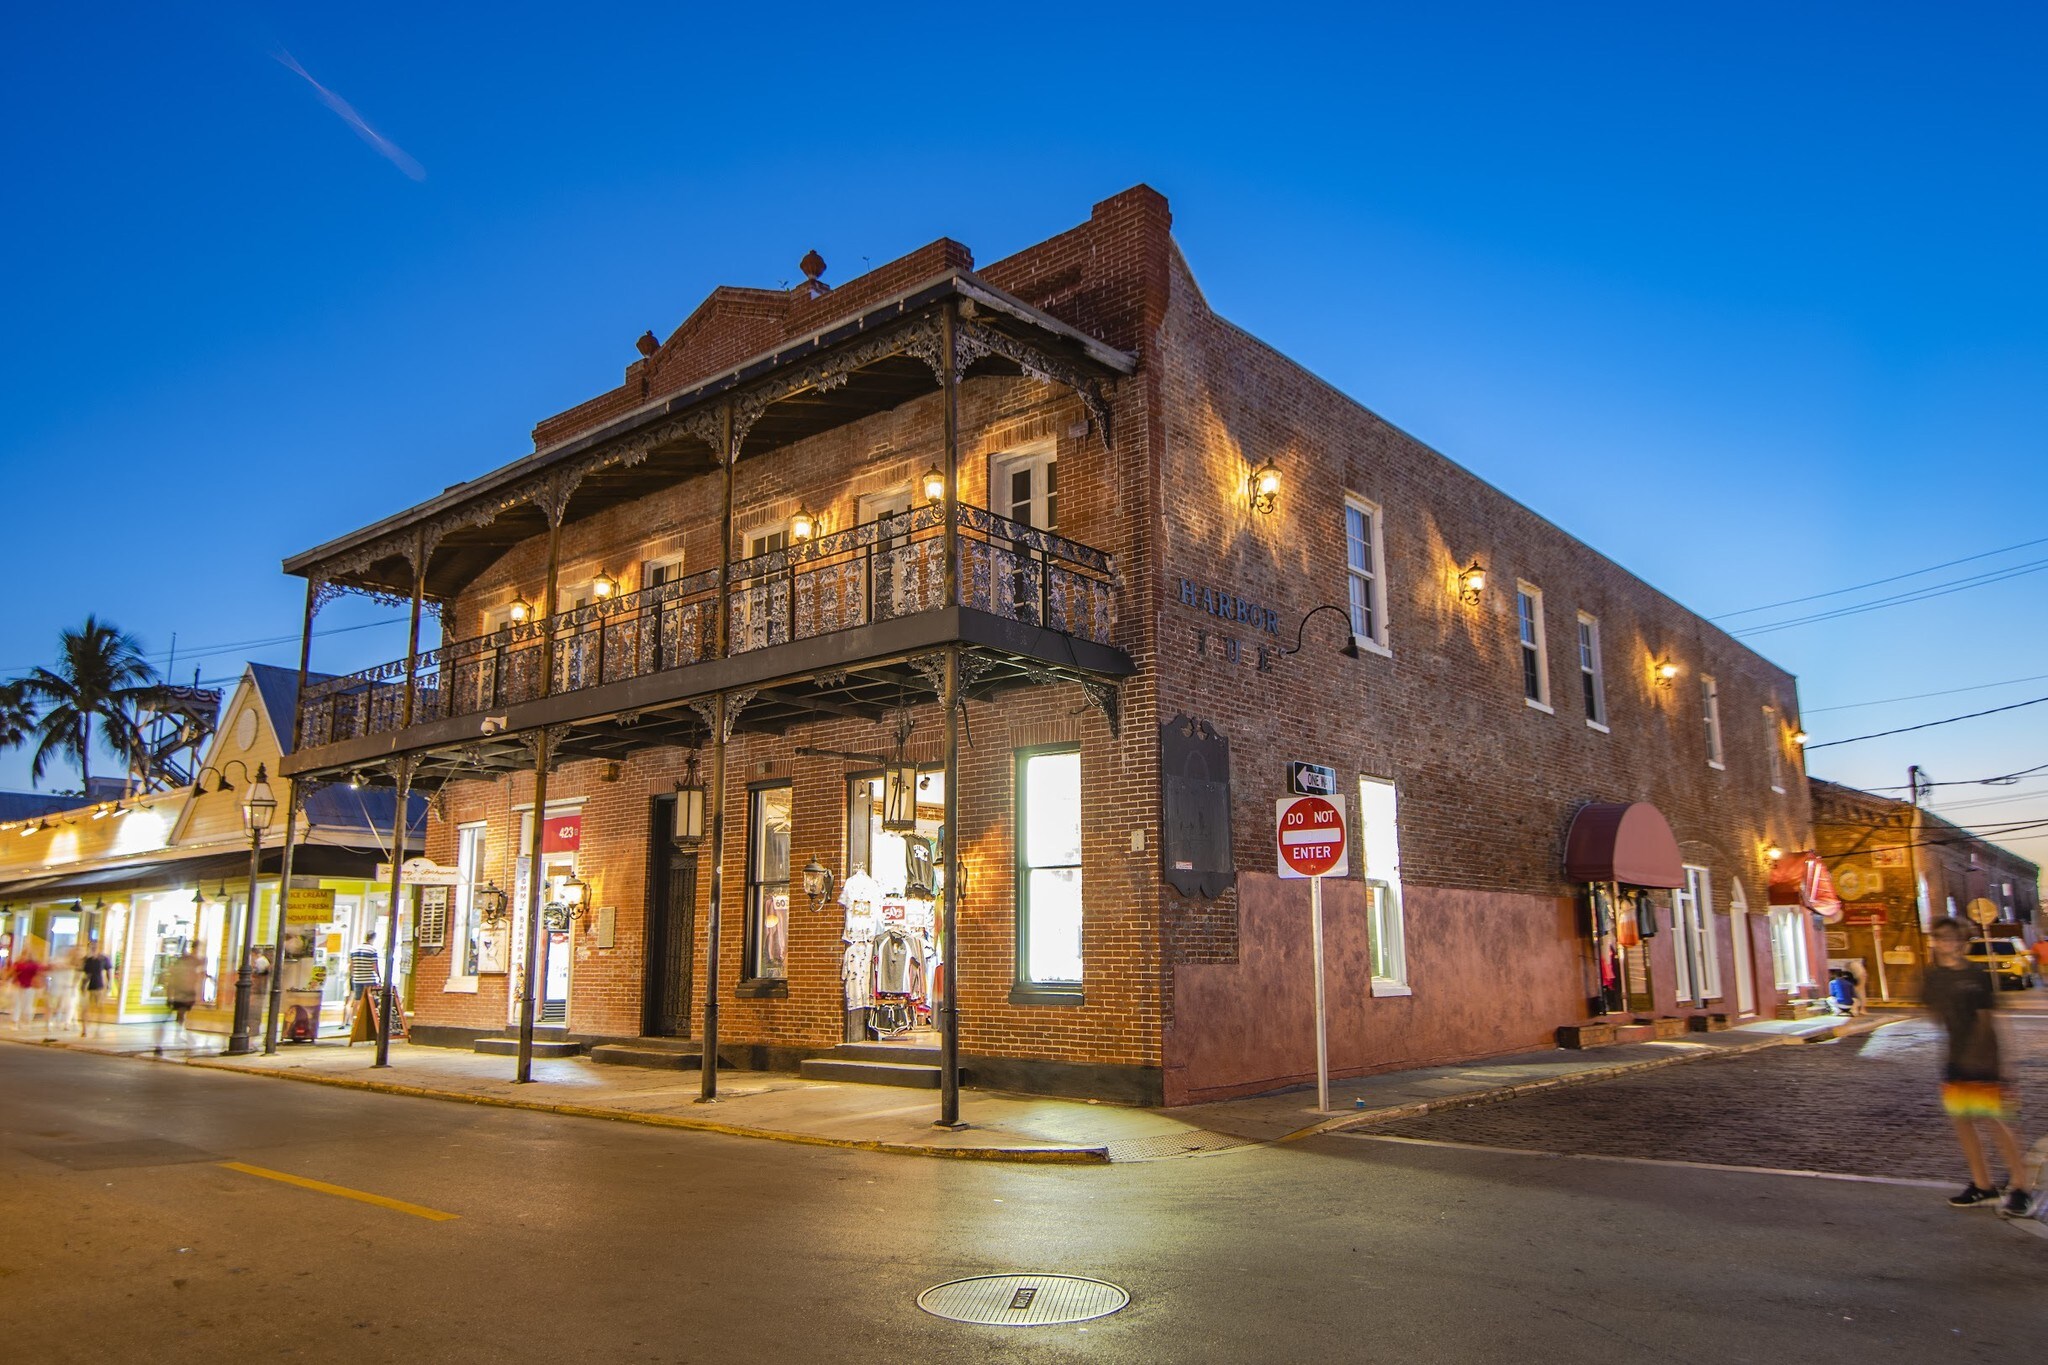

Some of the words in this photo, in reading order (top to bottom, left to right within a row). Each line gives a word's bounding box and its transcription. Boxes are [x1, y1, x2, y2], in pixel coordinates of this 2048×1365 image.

[1179, 577, 1279, 636] HARBOR
[1308, 773, 1320, 787] ONE
[1288, 813, 1304, 825] DO
[1314, 810, 1334, 823] NOT
[559, 826, 574, 838] 423
[1293, 846, 1331, 859] ENTER
